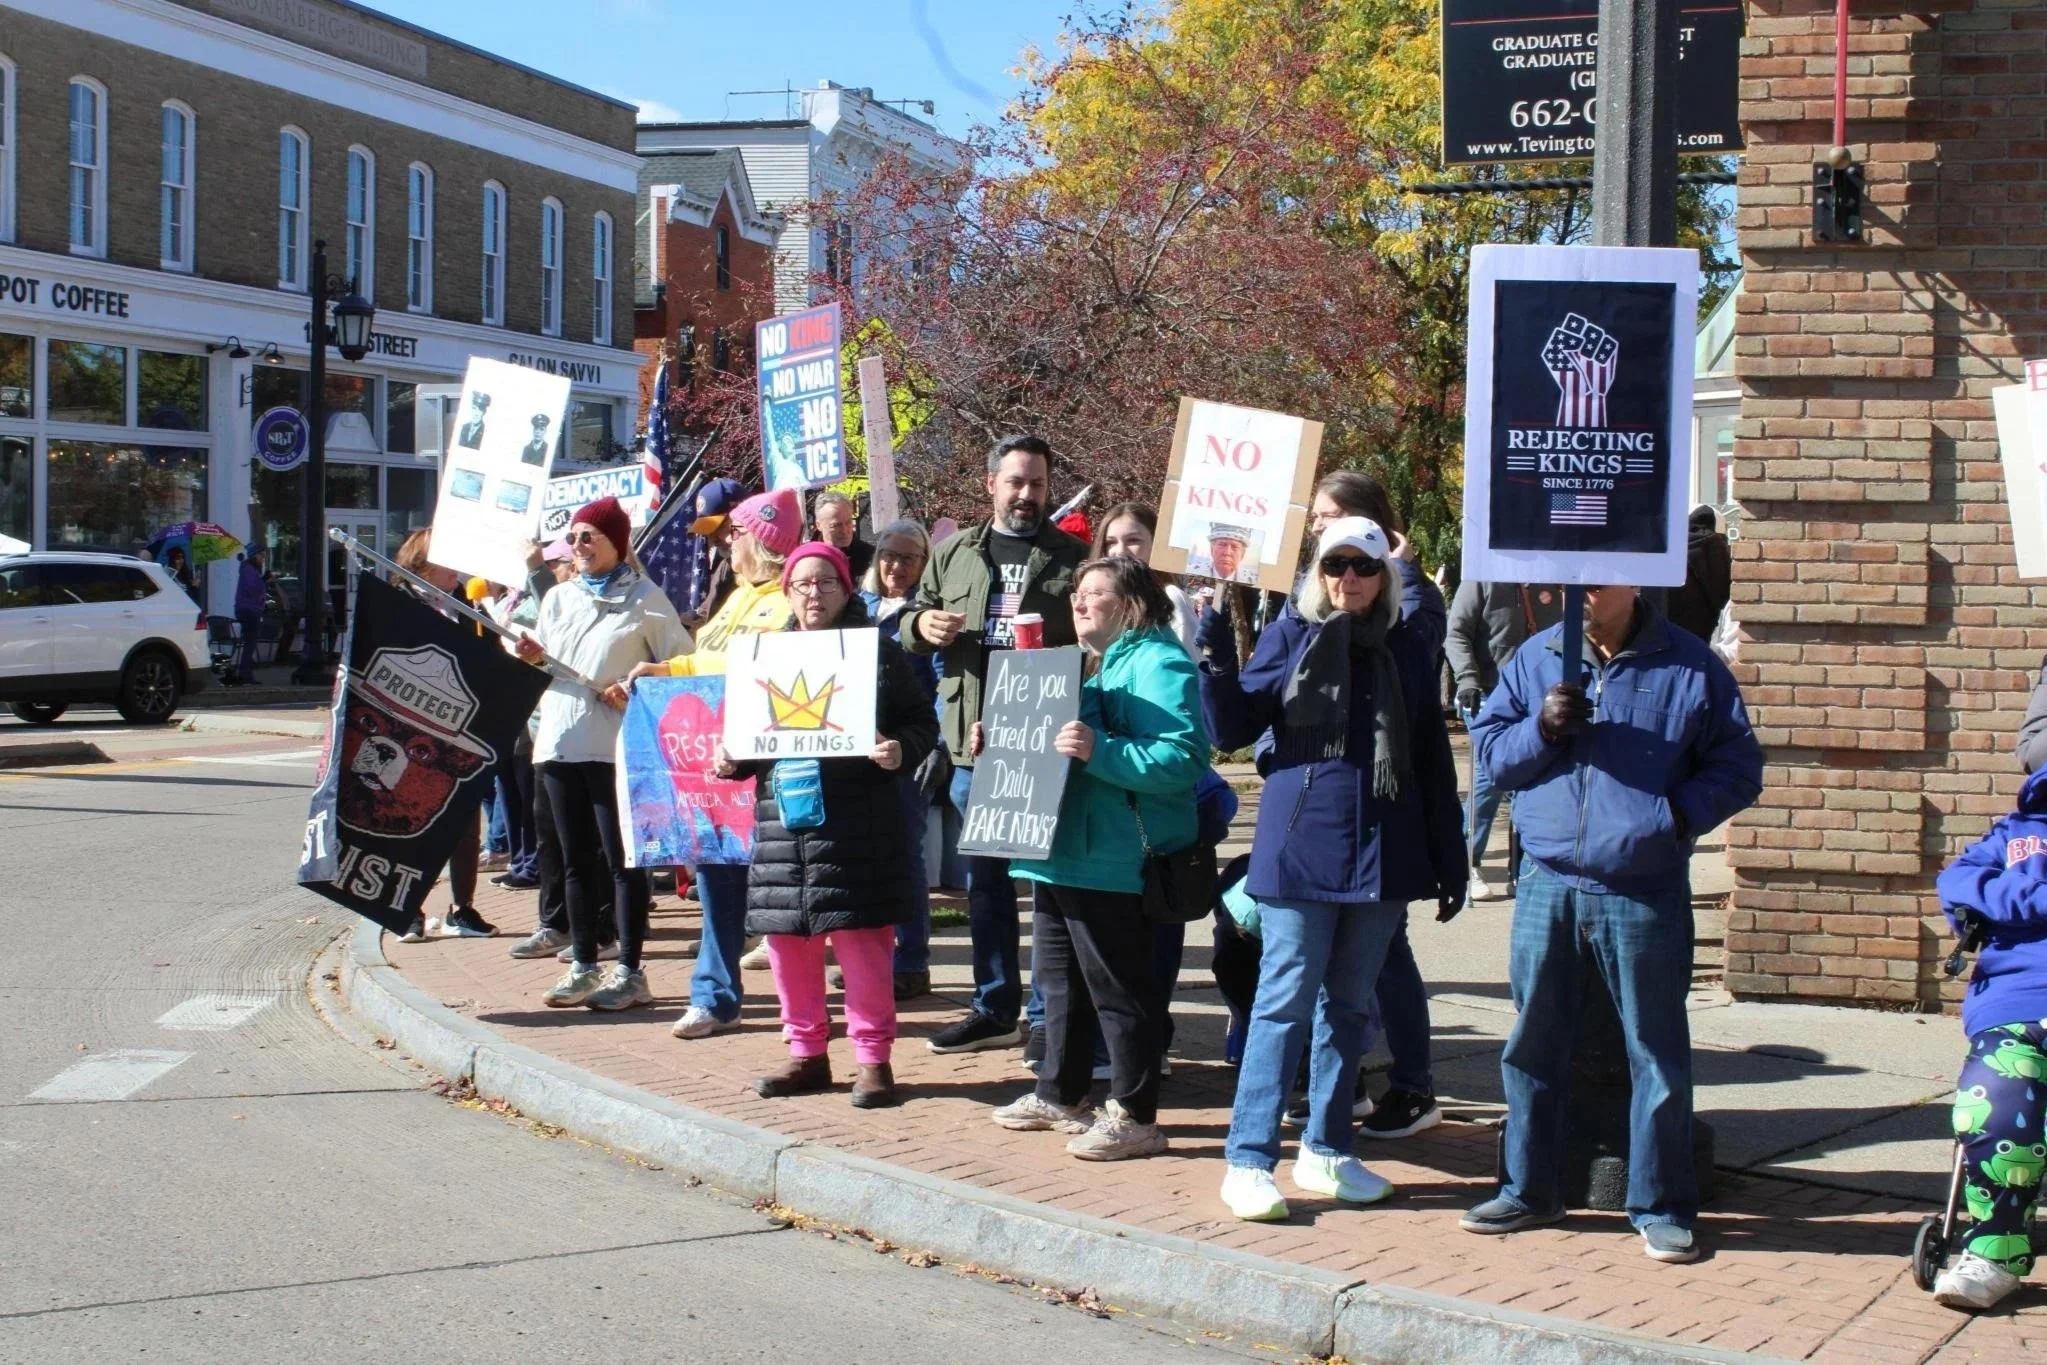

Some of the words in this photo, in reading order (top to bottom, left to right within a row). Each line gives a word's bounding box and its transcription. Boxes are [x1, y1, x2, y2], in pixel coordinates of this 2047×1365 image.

[1492, 33, 1583, 51] GRADUATE
[1503, 51, 1596, 69] GRADUATE
[52, 283, 129, 318] COFFEE
[368, 332, 419, 358] STREET
[761, 323, 787, 358] NO
[561, 360, 601, 384] SAVVI
[773, 368, 796, 398] NO
[797, 359, 835, 392] WAR
[803, 396, 837, 441] NO
[1200, 433, 1263, 472] NO
[1507, 429, 1655, 452] REJECTING
[805, 439, 841, 481] ICE
[1538, 453, 1623, 474] KINGS
[545, 469, 642, 509] DEMOCRACY
[1186, 485, 1269, 518] KINGS
[1543, 478, 1583, 489] SINCE
[1585, 478, 1615, 490] 1776
[545, 511, 568, 531] NOT
[373, 664, 464, 724] PROTECT
[990, 658, 1029, 706] Are
[1035, 673, 1068, 710] you
[664, 732, 723, 770] RESI
[754, 736, 778, 753] NO
[793, 735, 855, 752] KINGS
[988, 713, 1030, 752] tired
[1030, 714, 1052, 754] of
[990, 758, 1035, 816] Daily
[963, 803, 1010, 843] FAKE
[331, 844, 424, 912] IST
